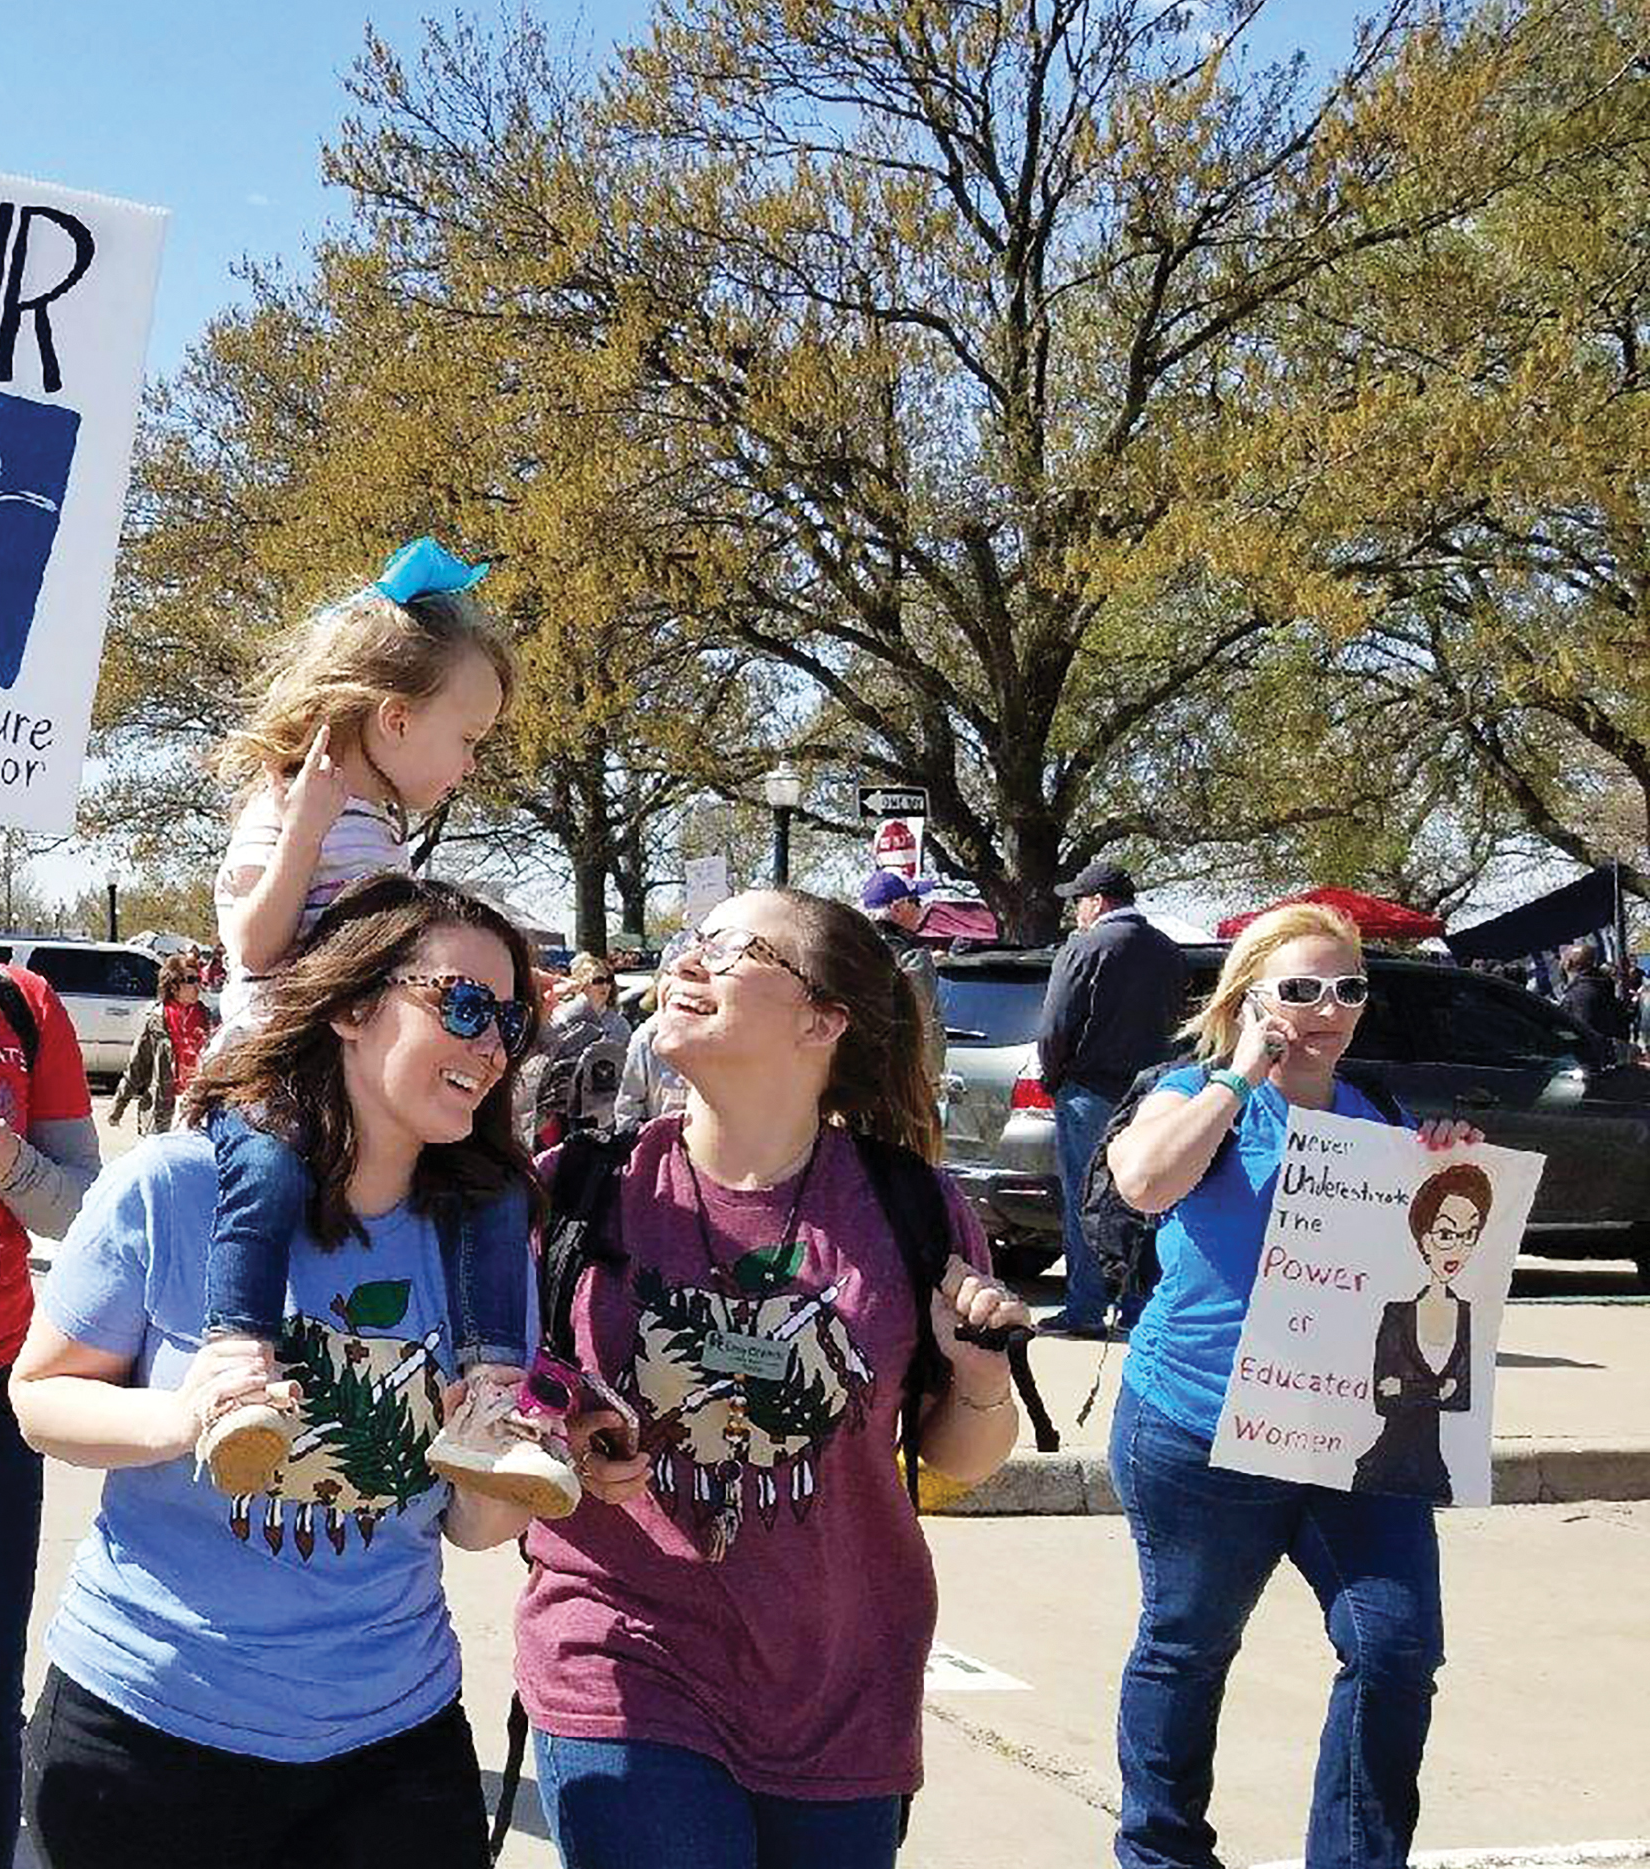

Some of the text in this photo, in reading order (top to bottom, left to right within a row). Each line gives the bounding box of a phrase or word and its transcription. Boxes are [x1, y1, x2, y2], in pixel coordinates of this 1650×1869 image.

[1287, 1131, 1353, 1154] Never
[1276, 1209, 1323, 1232] The
[1263, 1246, 1370, 1292] Power
[1240, 1357, 1369, 1400] Educated
[1234, 1415, 1342, 1450] Women
